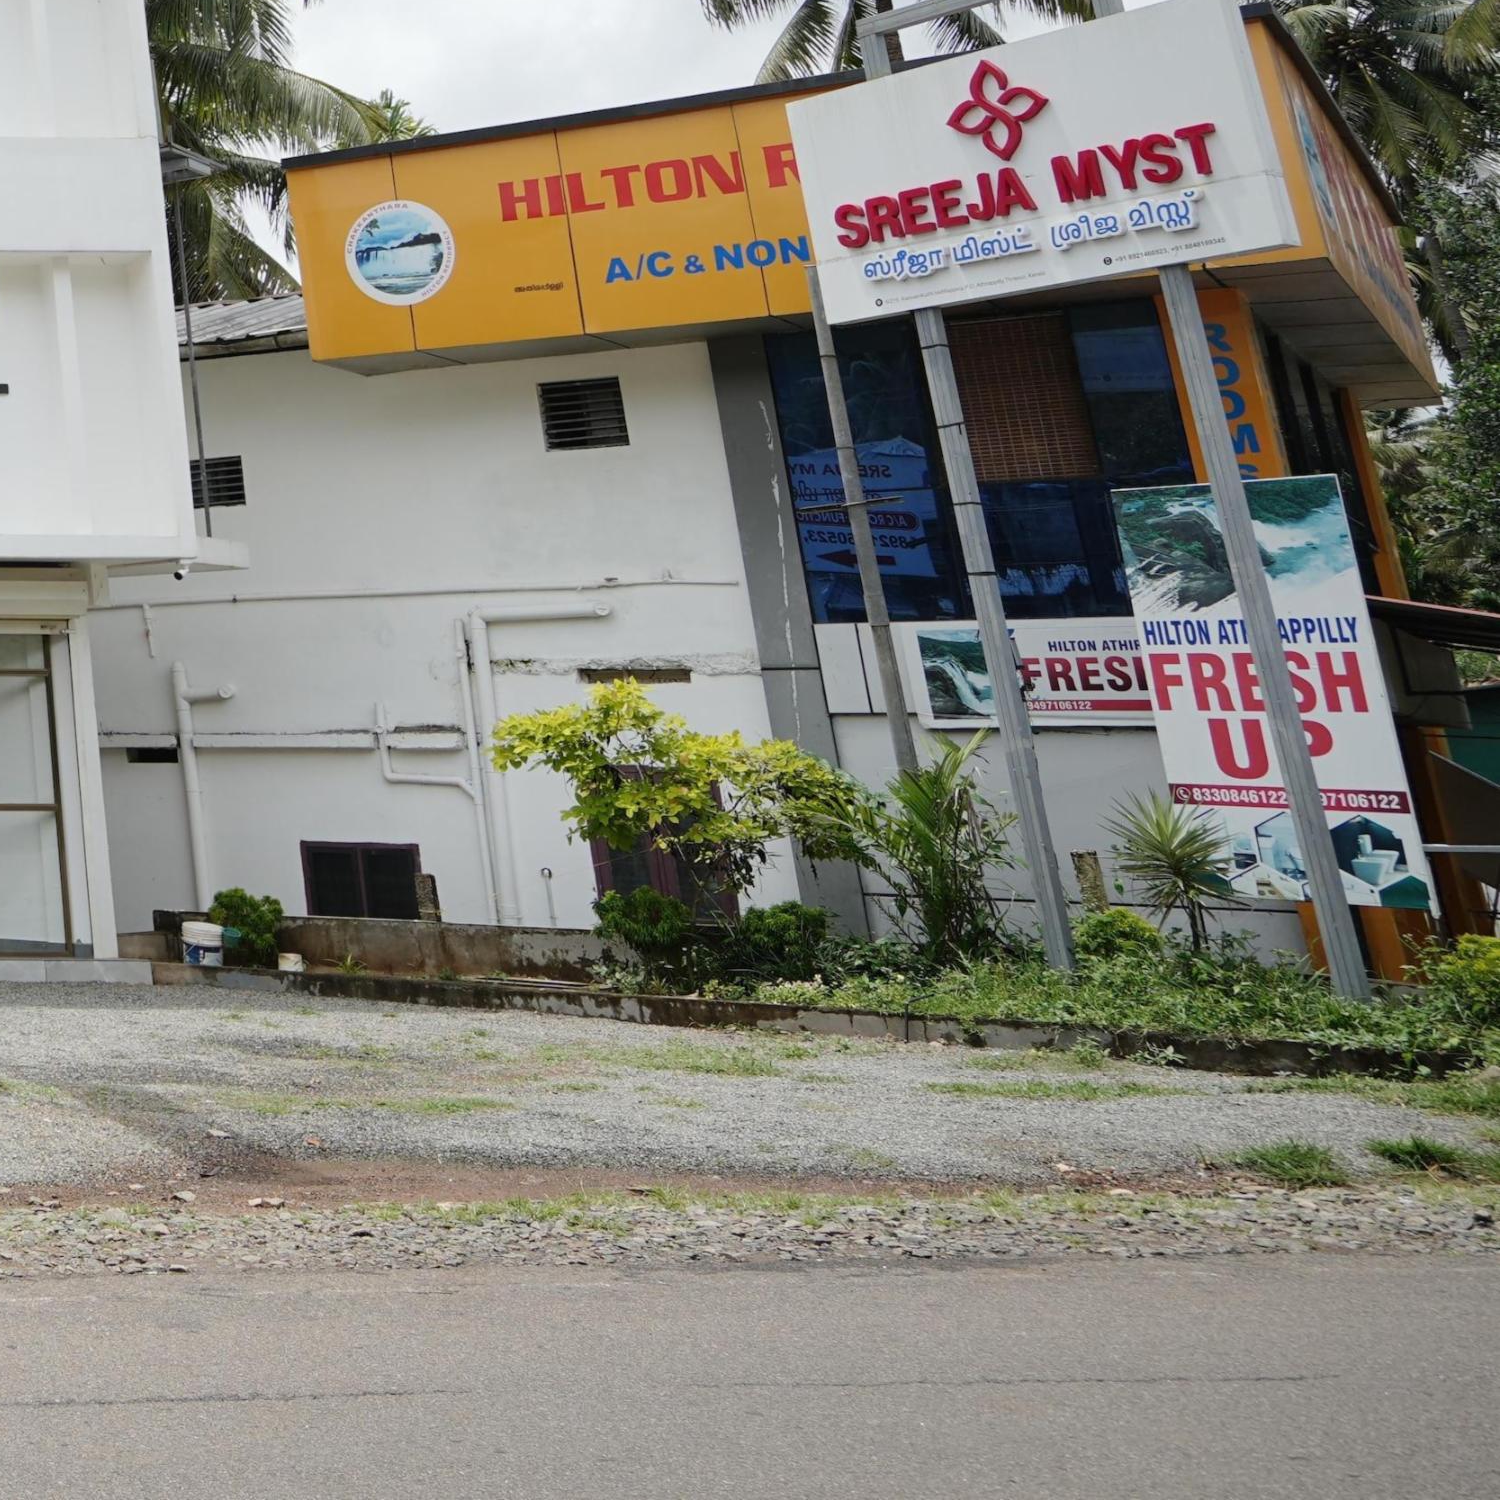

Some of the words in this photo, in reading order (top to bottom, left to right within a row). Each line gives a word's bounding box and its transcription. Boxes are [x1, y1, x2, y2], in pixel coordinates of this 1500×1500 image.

[498, 150, 745, 222] HILTON
[834, 168, 1038, 249] SREEJA
[1050, 123, 1216, 203] MYST
[952, 228, 1033, 262] மிஸ்ட்
[1050, 215, 1118, 249] ശ്രീജ
[605, 251, 675, 284] A/C
[684, 255, 706, 274] &
[713, 236, 811, 271] NON
[1048, 640, 1097, 652] HILTON
[1142, 619, 1212, 646] HILTON
[1148, 651, 1369, 713] FRESH
[1027, 701, 1092, 710] 9497106122
[1193, 787, 1288, 805] 8330846122
